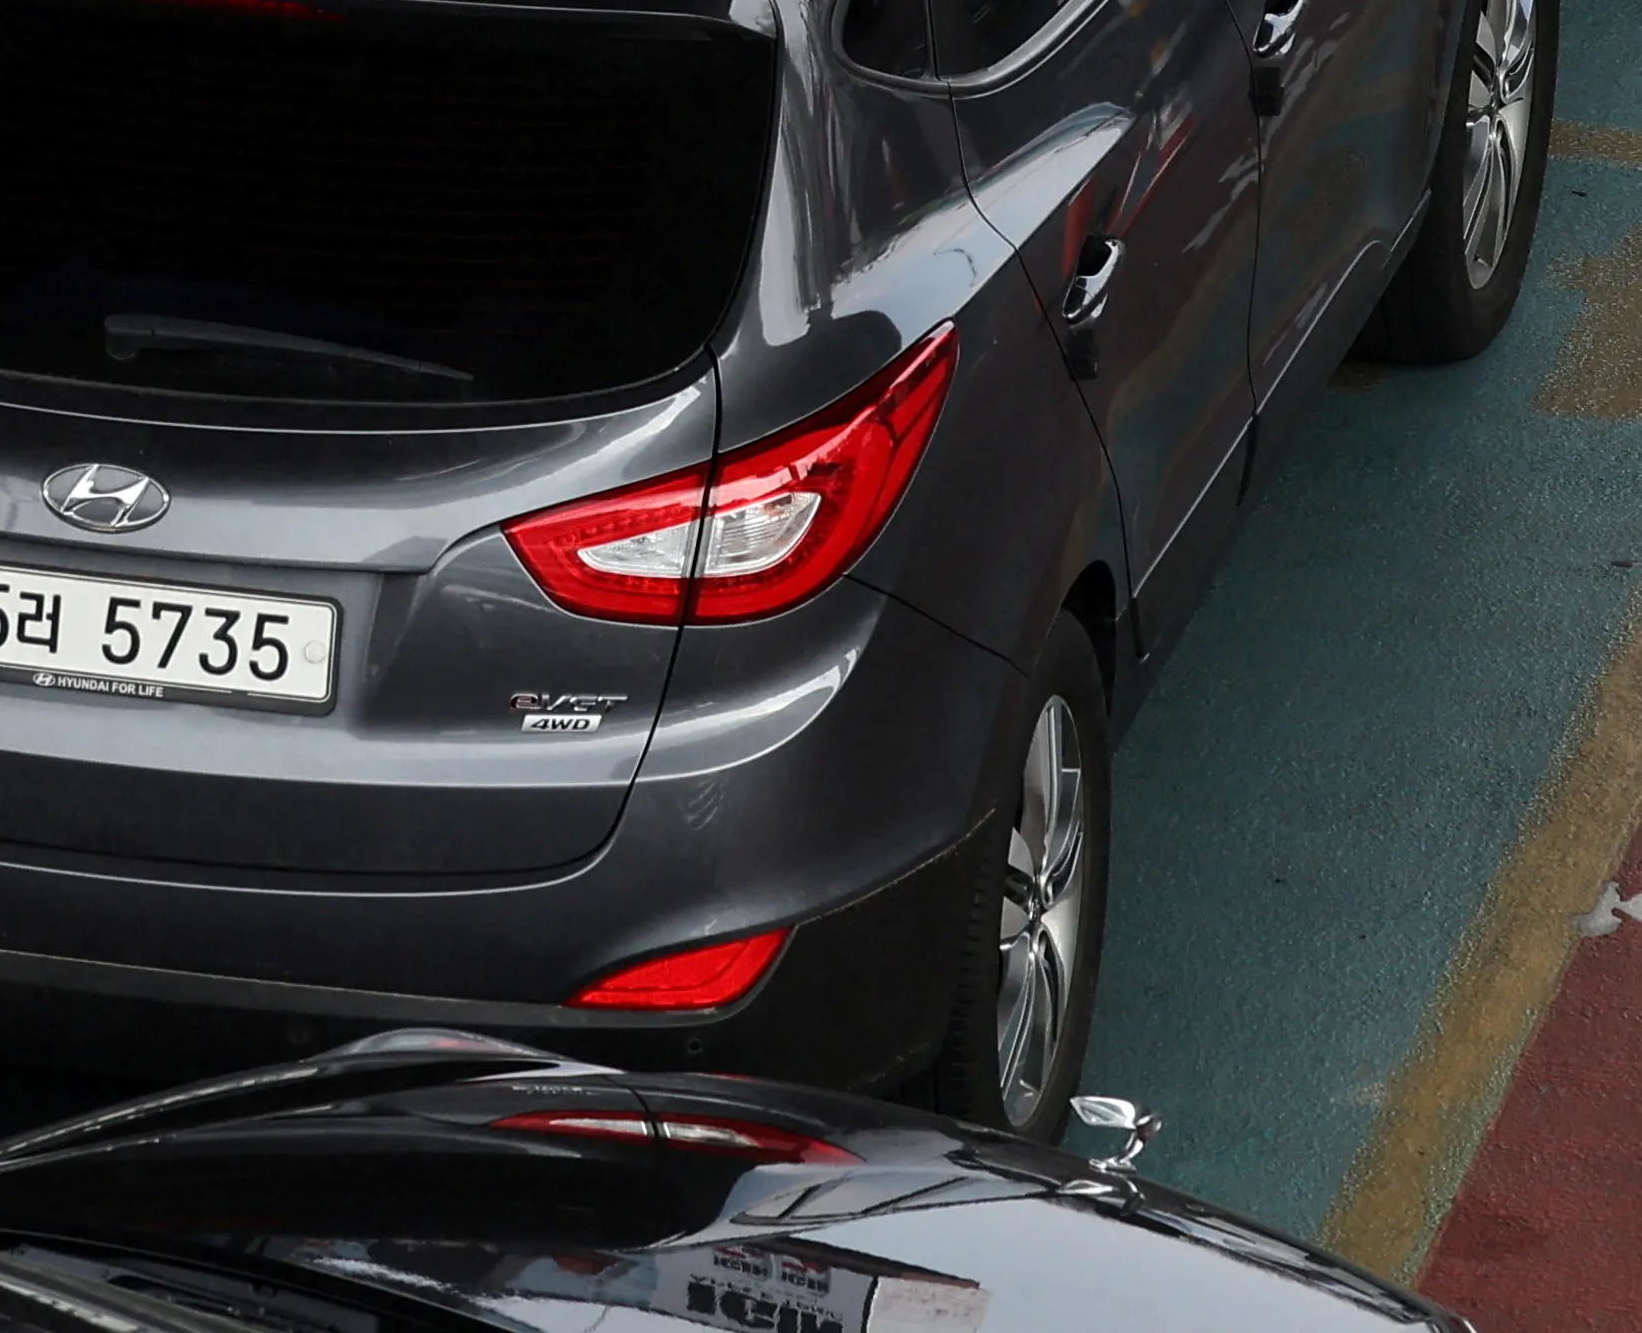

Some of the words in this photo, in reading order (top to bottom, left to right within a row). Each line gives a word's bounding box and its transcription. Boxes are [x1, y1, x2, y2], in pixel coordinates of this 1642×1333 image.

[101, 596, 290, 682] 5735
[57, 675, 110, 692] HYUNDAI
[111, 681, 136, 695] FOR
[137, 683, 164, 698] LIFE
[530, 718, 591, 730] 4WD
